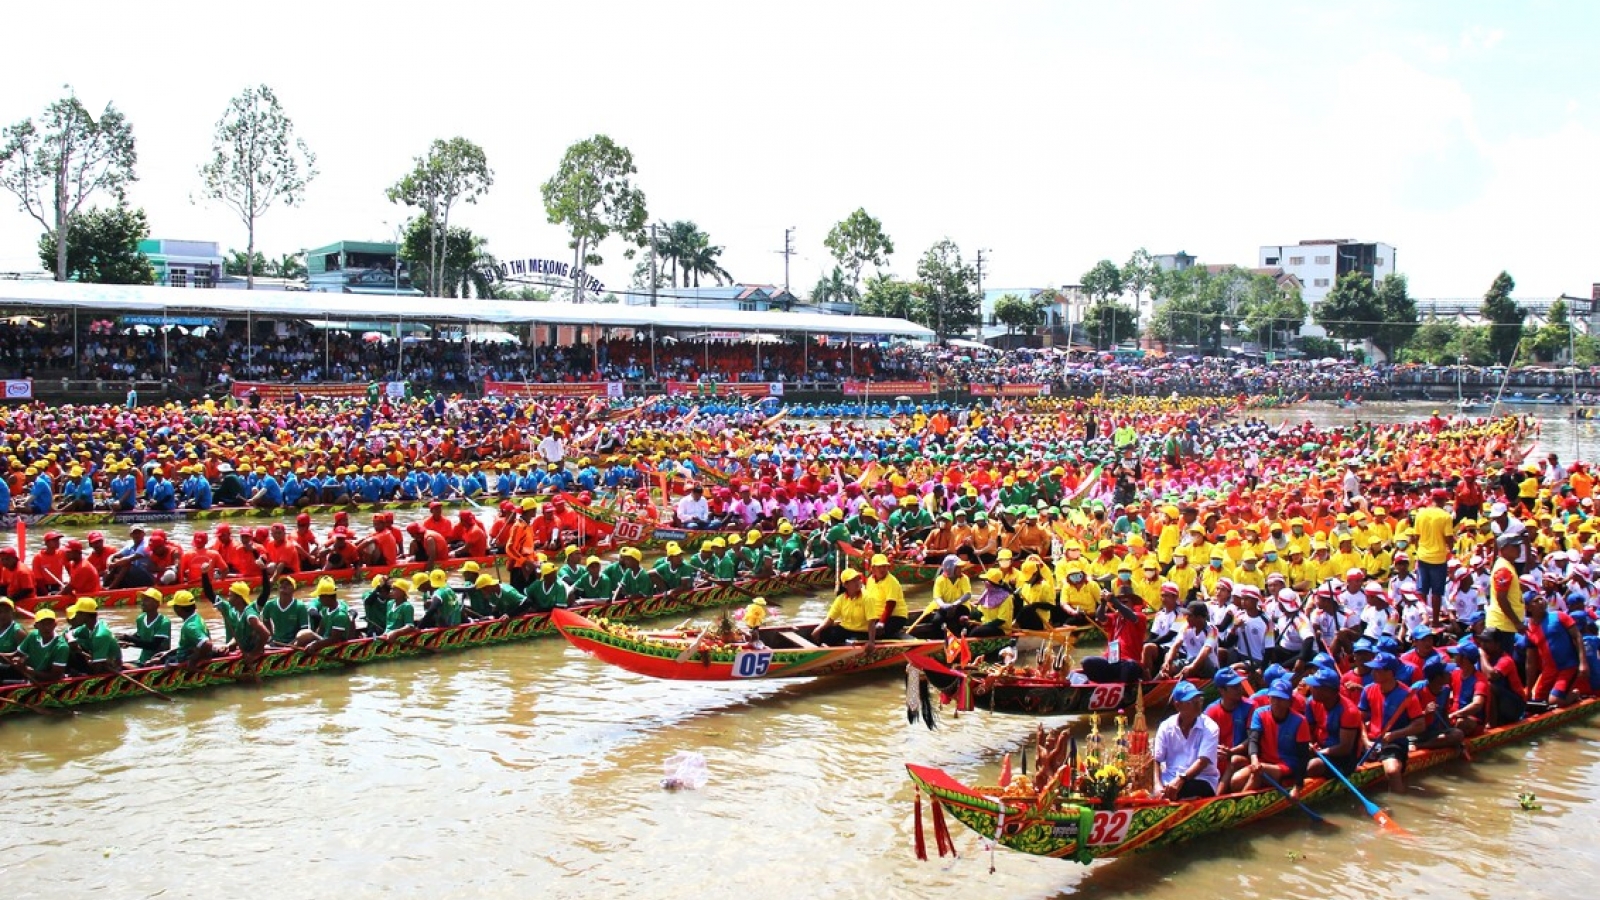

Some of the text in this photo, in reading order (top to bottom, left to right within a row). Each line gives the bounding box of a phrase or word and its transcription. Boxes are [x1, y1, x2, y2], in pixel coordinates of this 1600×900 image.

[529, 258, 569, 277] MEKONG
[619, 522, 639, 540] 06
[739, 652, 771, 676] 05
[1090, 686, 1122, 709] 36
[1086, 812, 1128, 844] 32
